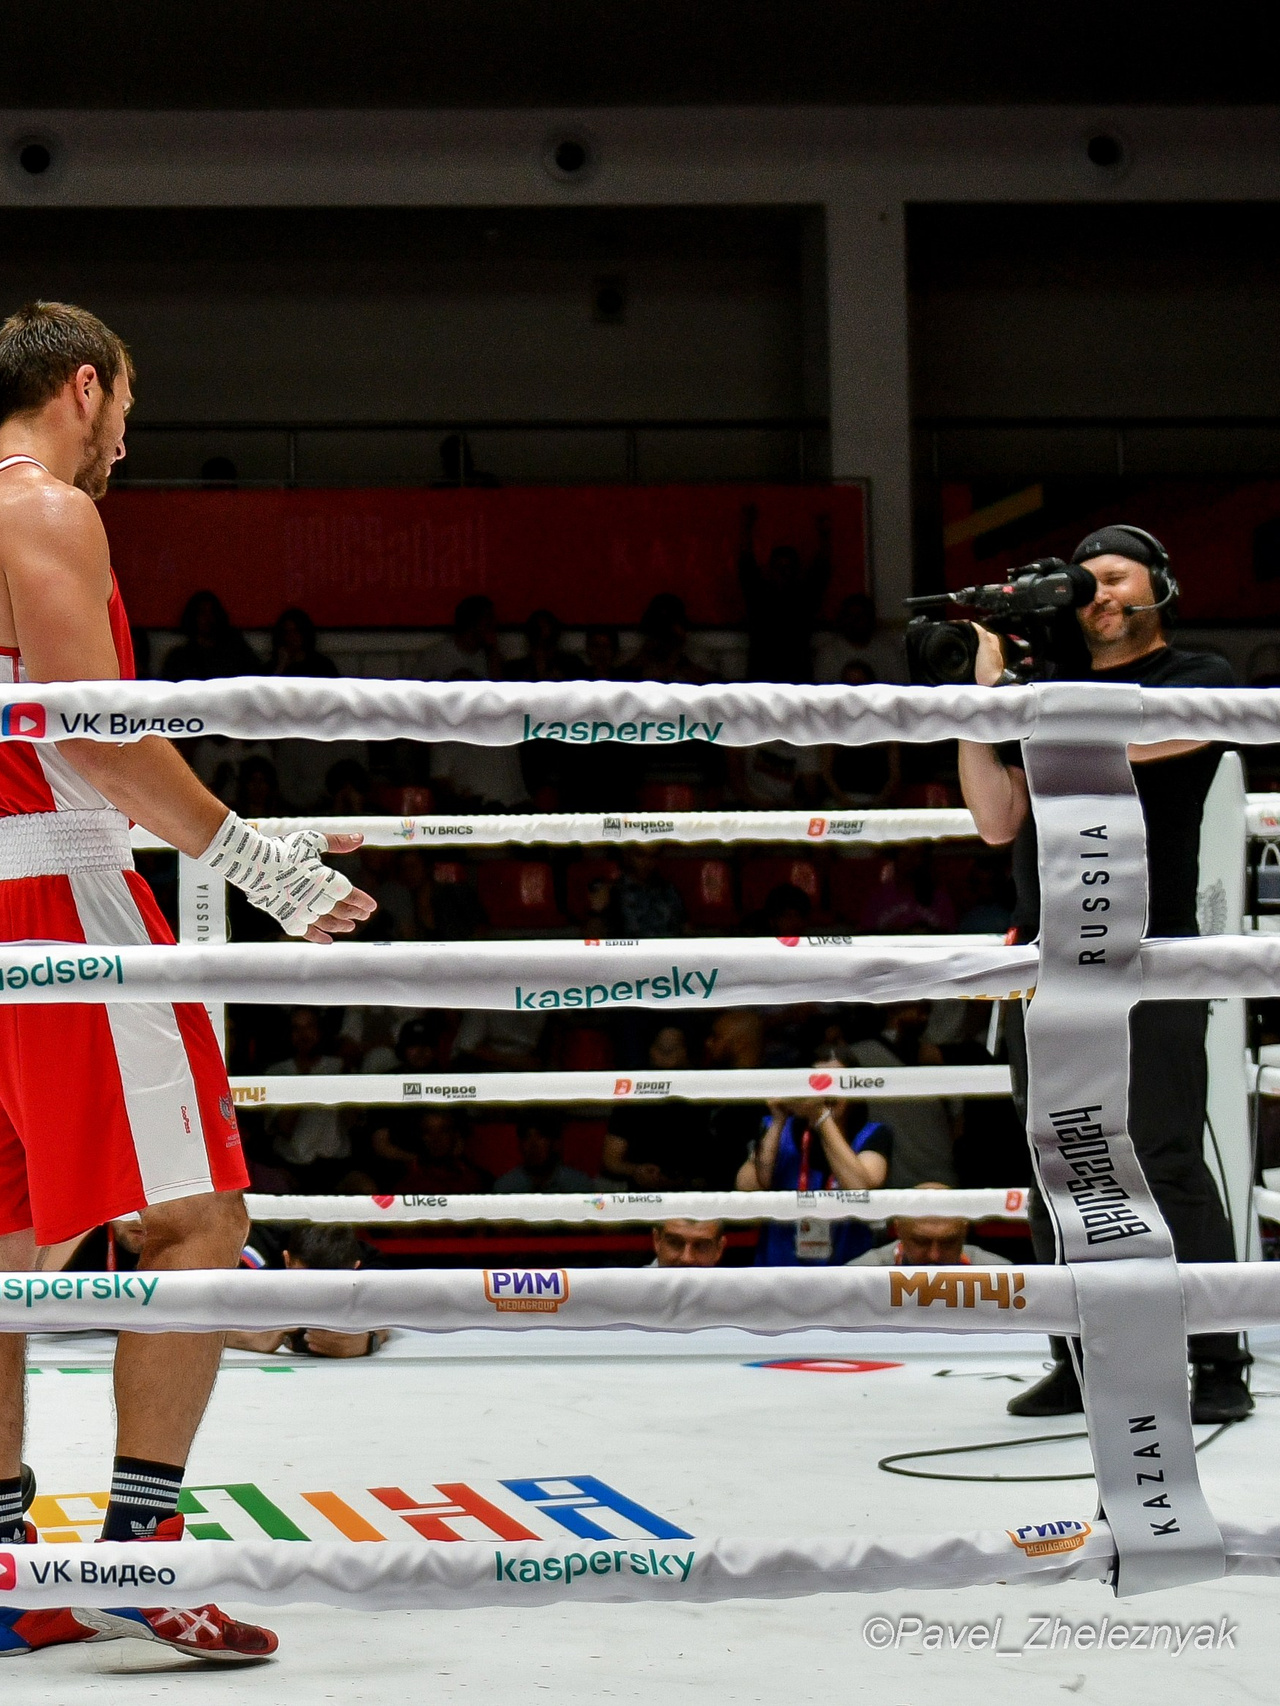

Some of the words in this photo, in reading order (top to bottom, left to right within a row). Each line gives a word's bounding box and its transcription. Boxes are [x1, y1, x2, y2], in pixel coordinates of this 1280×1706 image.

[60, 713, 101, 734] VK
[110, 713, 204, 734] Видео
[523, 714, 723, 743] kaspersky
[422, 826, 437, 835] TV
[439, 825, 473, 835] BRICS
[1079, 824, 1109, 965] RUSSIA
[197, 883, 209, 942] RUSSIA
[515, 965, 718, 1008] kaspersky
[425, 1085, 476, 1098] первое
[635, 1081, 671, 1090] SPORT
[839, 1075, 884, 1089] Likee
[493, 1271, 560, 1294] РИМ
[890, 1271, 1026, 1309] МАТЧ!
[499, 1301, 556, 1311] MEDIAGROUP
[1128, 1414, 1180, 1536] KAZAN
[1026, 1537, 1083, 1555] MEDIAGROUP
[31, 1561, 72, 1583] VK
[81, 1562, 176, 1586] Видео
[495, 1549, 695, 1584] kaspersky
